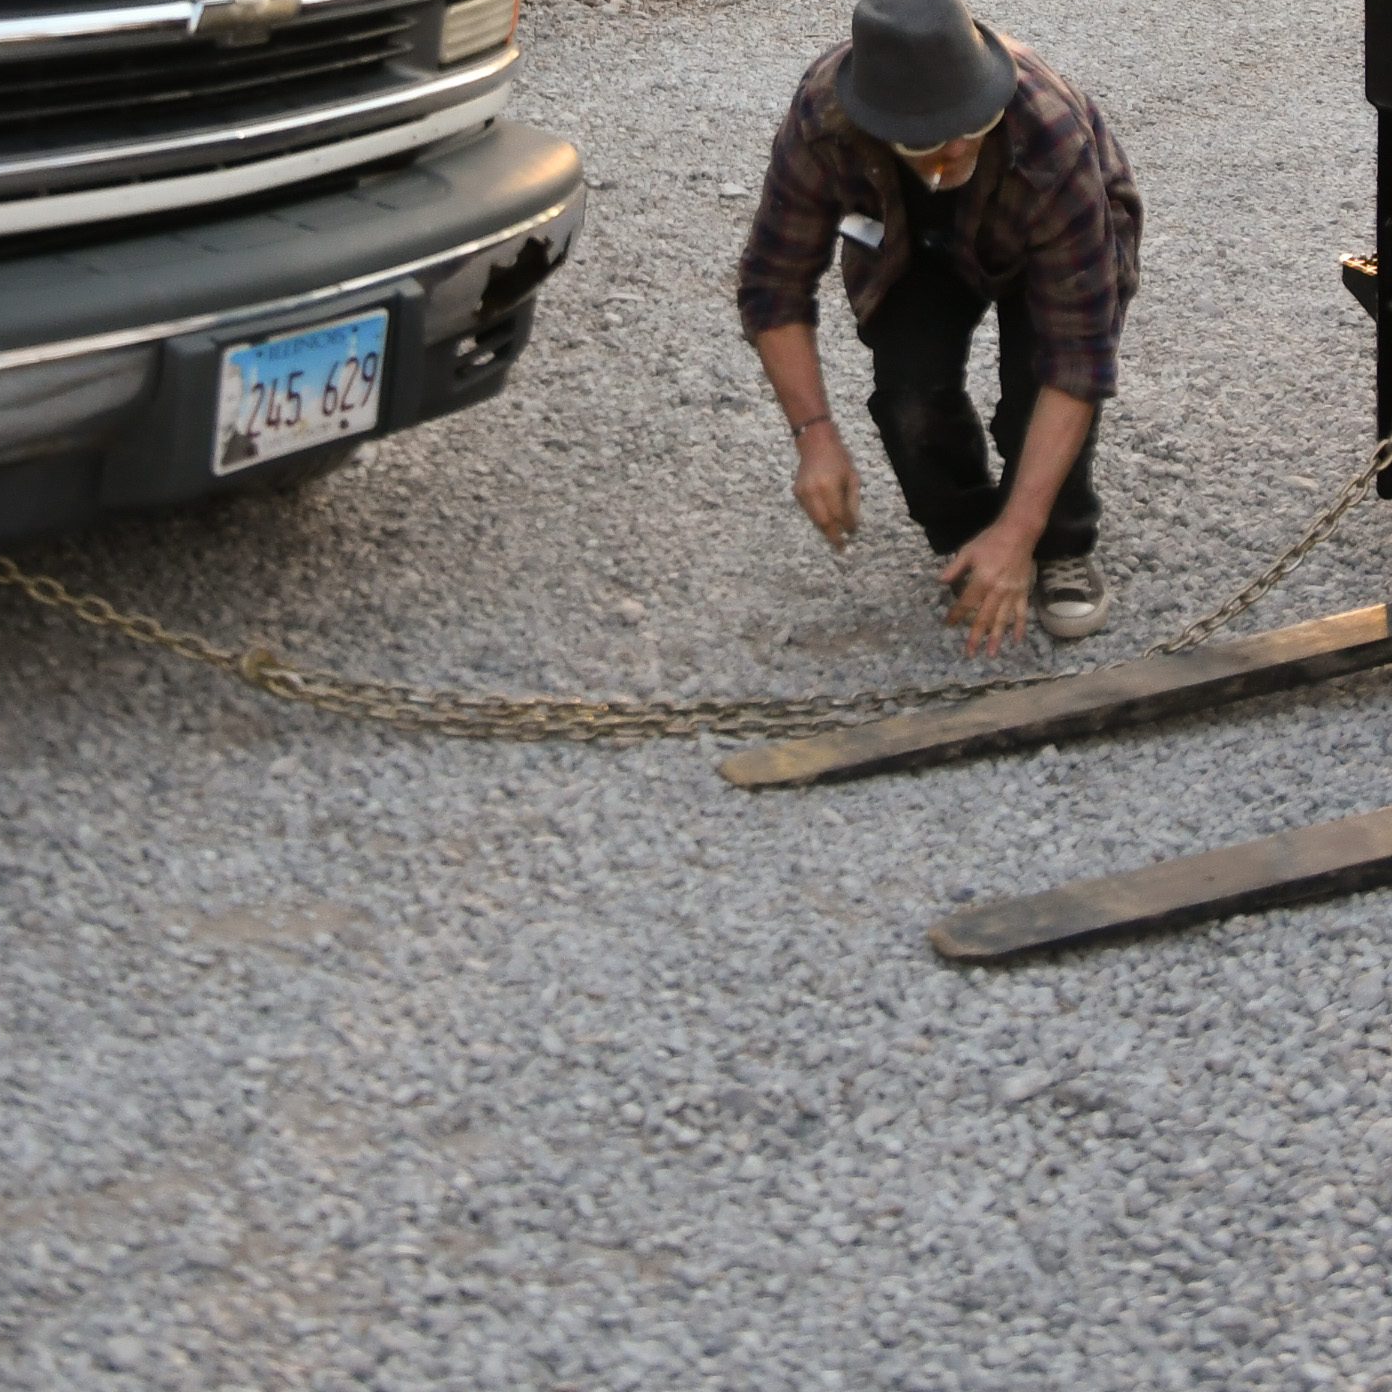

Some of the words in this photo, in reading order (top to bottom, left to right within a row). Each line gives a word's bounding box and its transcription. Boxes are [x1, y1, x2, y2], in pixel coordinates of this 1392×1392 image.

[269, 330, 347, 361] ILLINOIS
[246, 370, 304, 439] 245
[321, 351, 379, 417] 629
